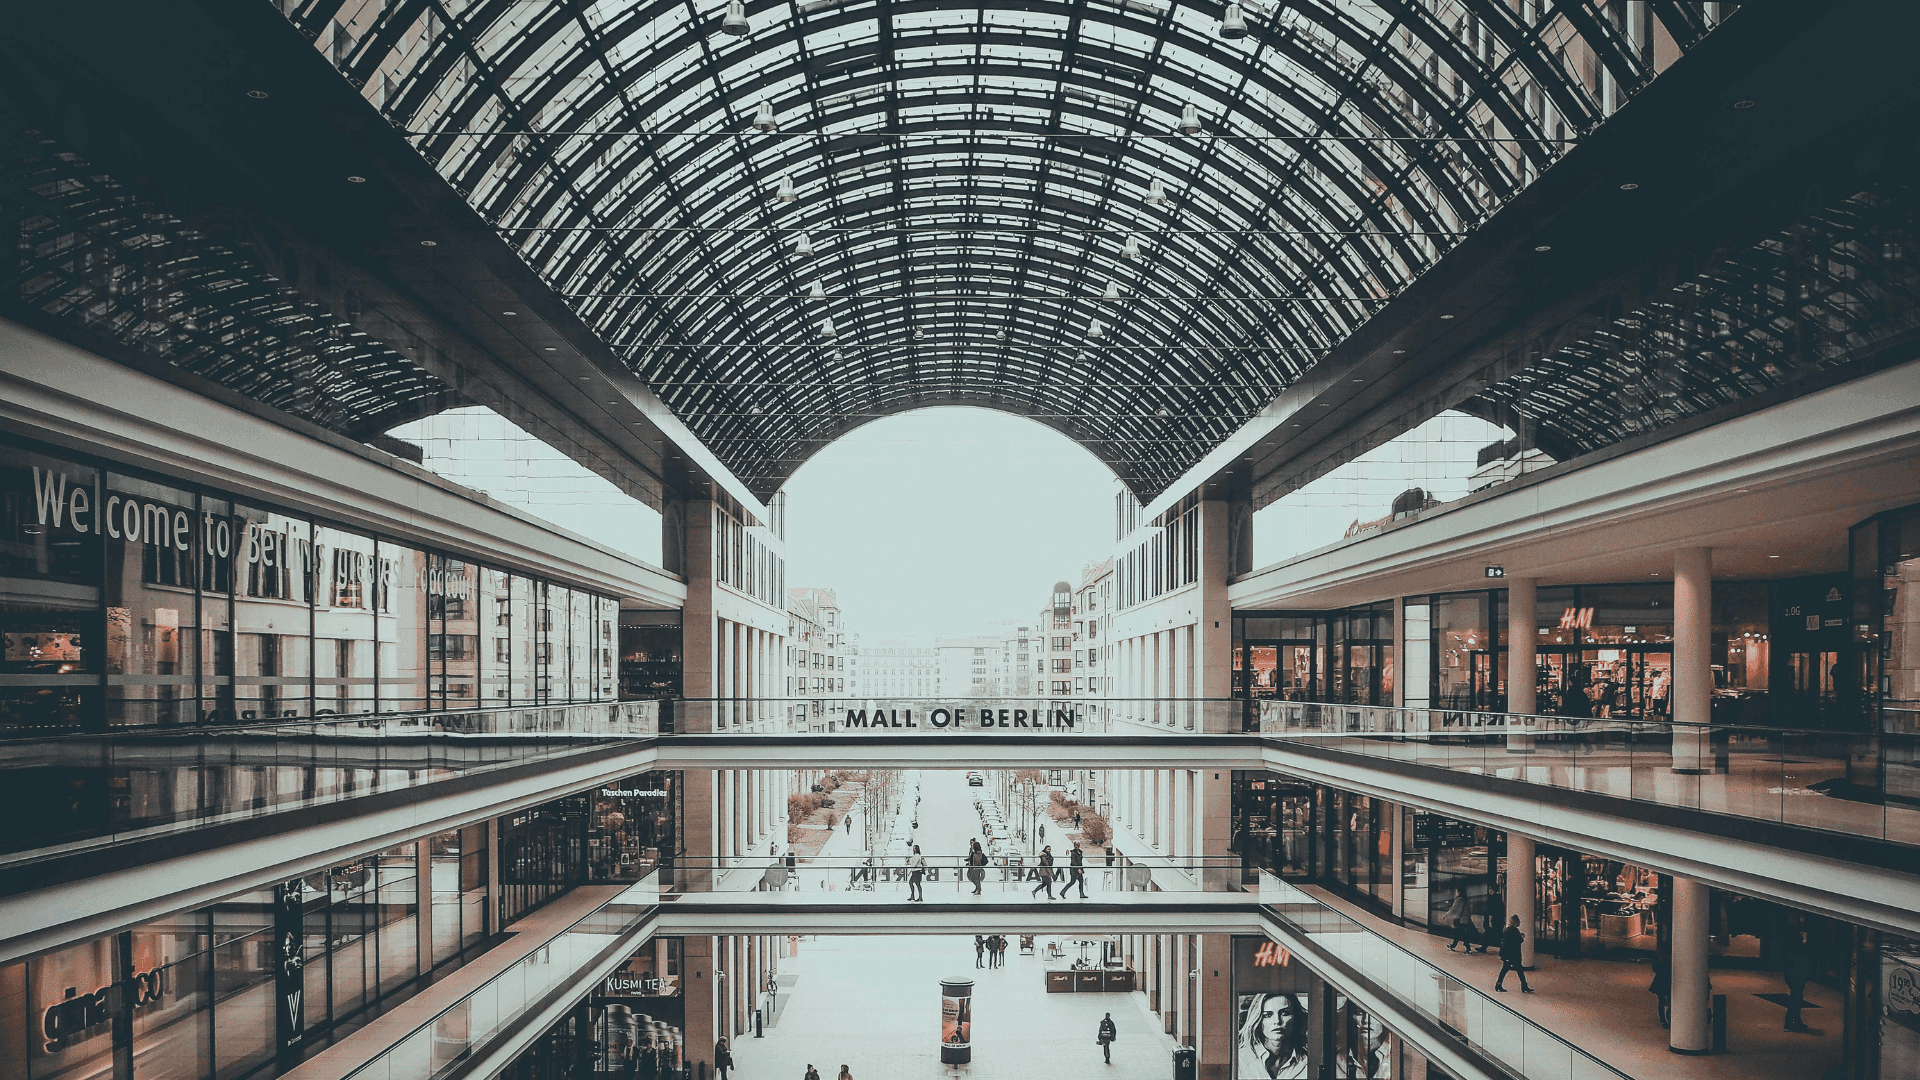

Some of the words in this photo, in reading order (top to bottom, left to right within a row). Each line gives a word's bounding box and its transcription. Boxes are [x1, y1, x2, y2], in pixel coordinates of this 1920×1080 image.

[32, 465, 189, 551] Welcome
[205, 507, 230, 558] to
[1560, 606, 1595, 630] H&M
[845, 709, 917, 728] MALL
[930, 708, 966, 728] OF
[980, 708, 1075, 728] BERLIN
[601, 788, 633, 797] Taschen
[633, 788, 668, 797] Paradies
[1254, 941, 1290, 968] H&M
[607, 976, 642, 992] KUSMI
[644, 977, 666, 992] TEA
